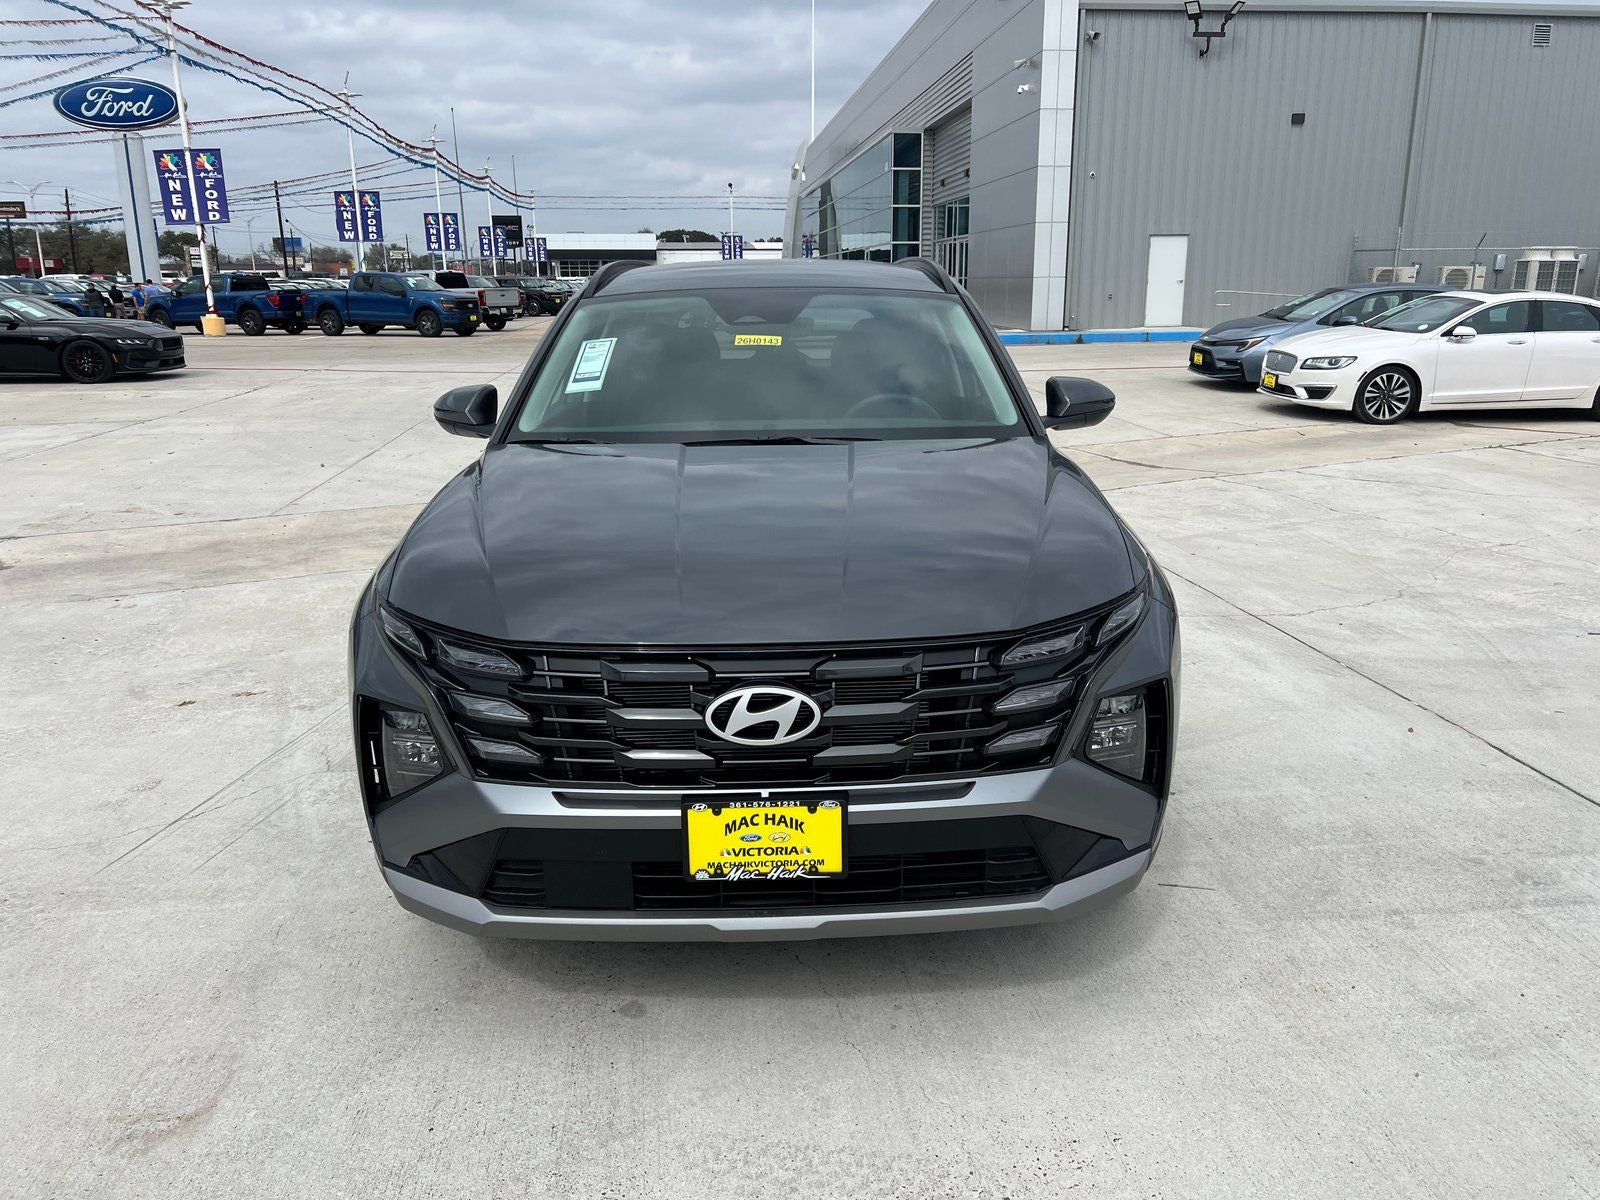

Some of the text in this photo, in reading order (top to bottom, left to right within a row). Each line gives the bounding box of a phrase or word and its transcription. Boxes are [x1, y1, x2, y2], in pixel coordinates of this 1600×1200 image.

[81, 86, 154, 117] Ford
[168, 179, 187, 221] NEW
[205, 178, 220, 221] FORD
[342, 211, 355, 240] NEW
[367, 211, 378, 240] FORD
[430, 228, 439, 250] NEW
[448, 227, 456, 250] FORD
[736, 337, 780, 345] 26H0143
[724, 813, 806, 836] MAC HAIK
[731, 846, 800, 857] VICTORIA
[725, 864, 809, 881] Mac Haik
